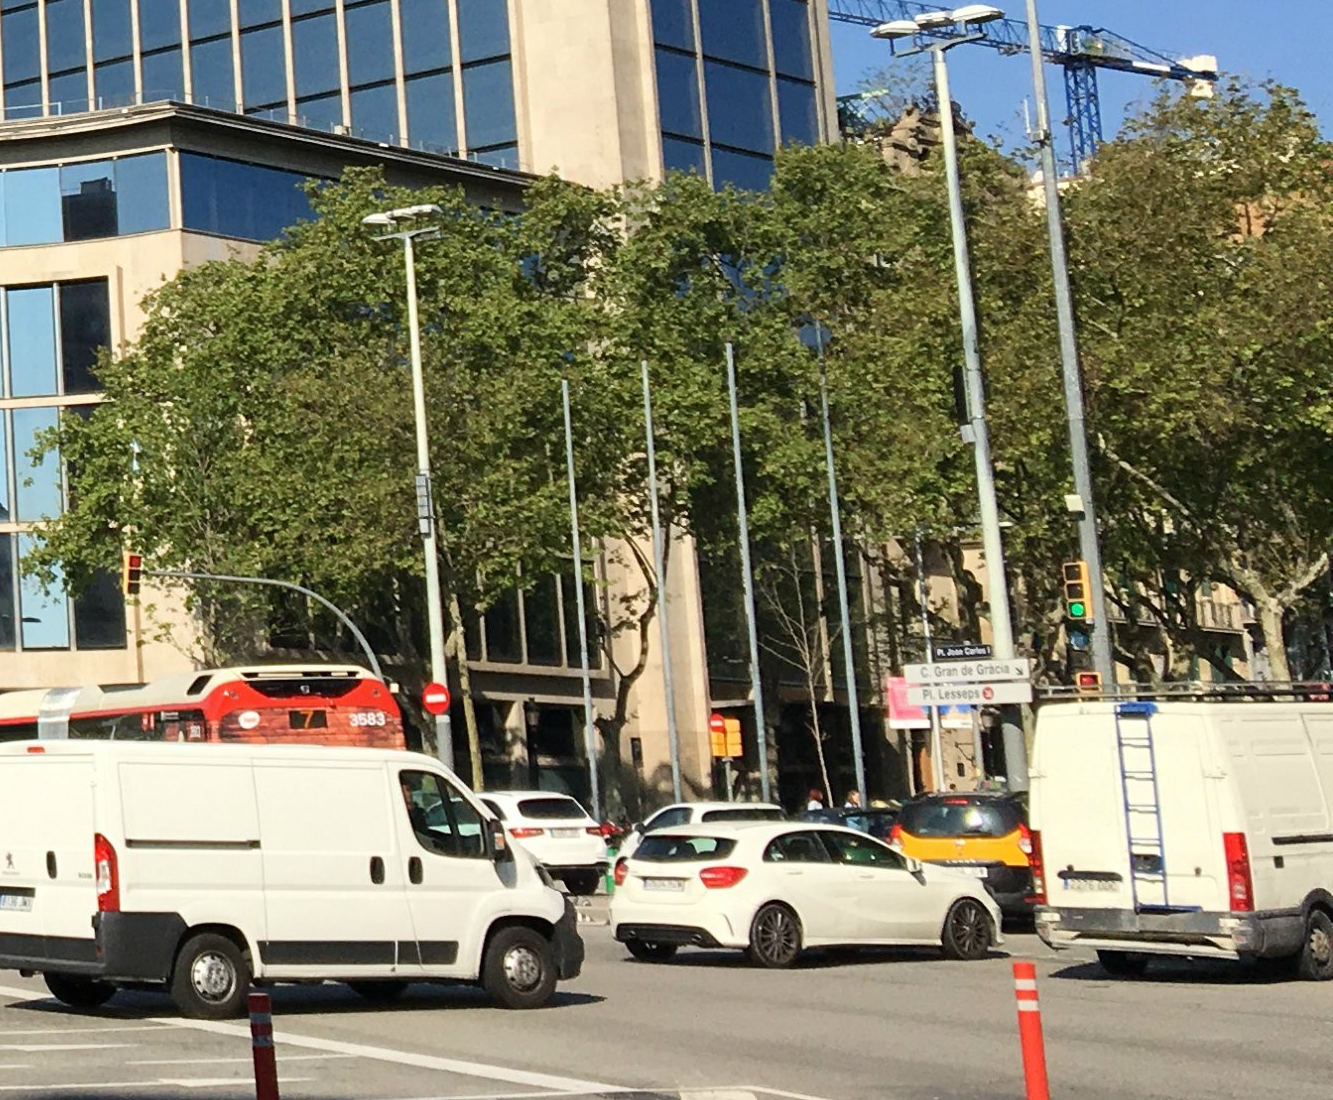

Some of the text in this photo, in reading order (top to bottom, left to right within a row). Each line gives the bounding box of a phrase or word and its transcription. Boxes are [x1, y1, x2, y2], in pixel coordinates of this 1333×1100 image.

[920, 666, 932, 678] C.
[934, 666, 958, 677] Gran
[961, 664, 973, 676] de
[938, 688, 980, 701] Lesseps
[299, 710, 313, 729] 7
[348, 712, 386, 727] 3583
